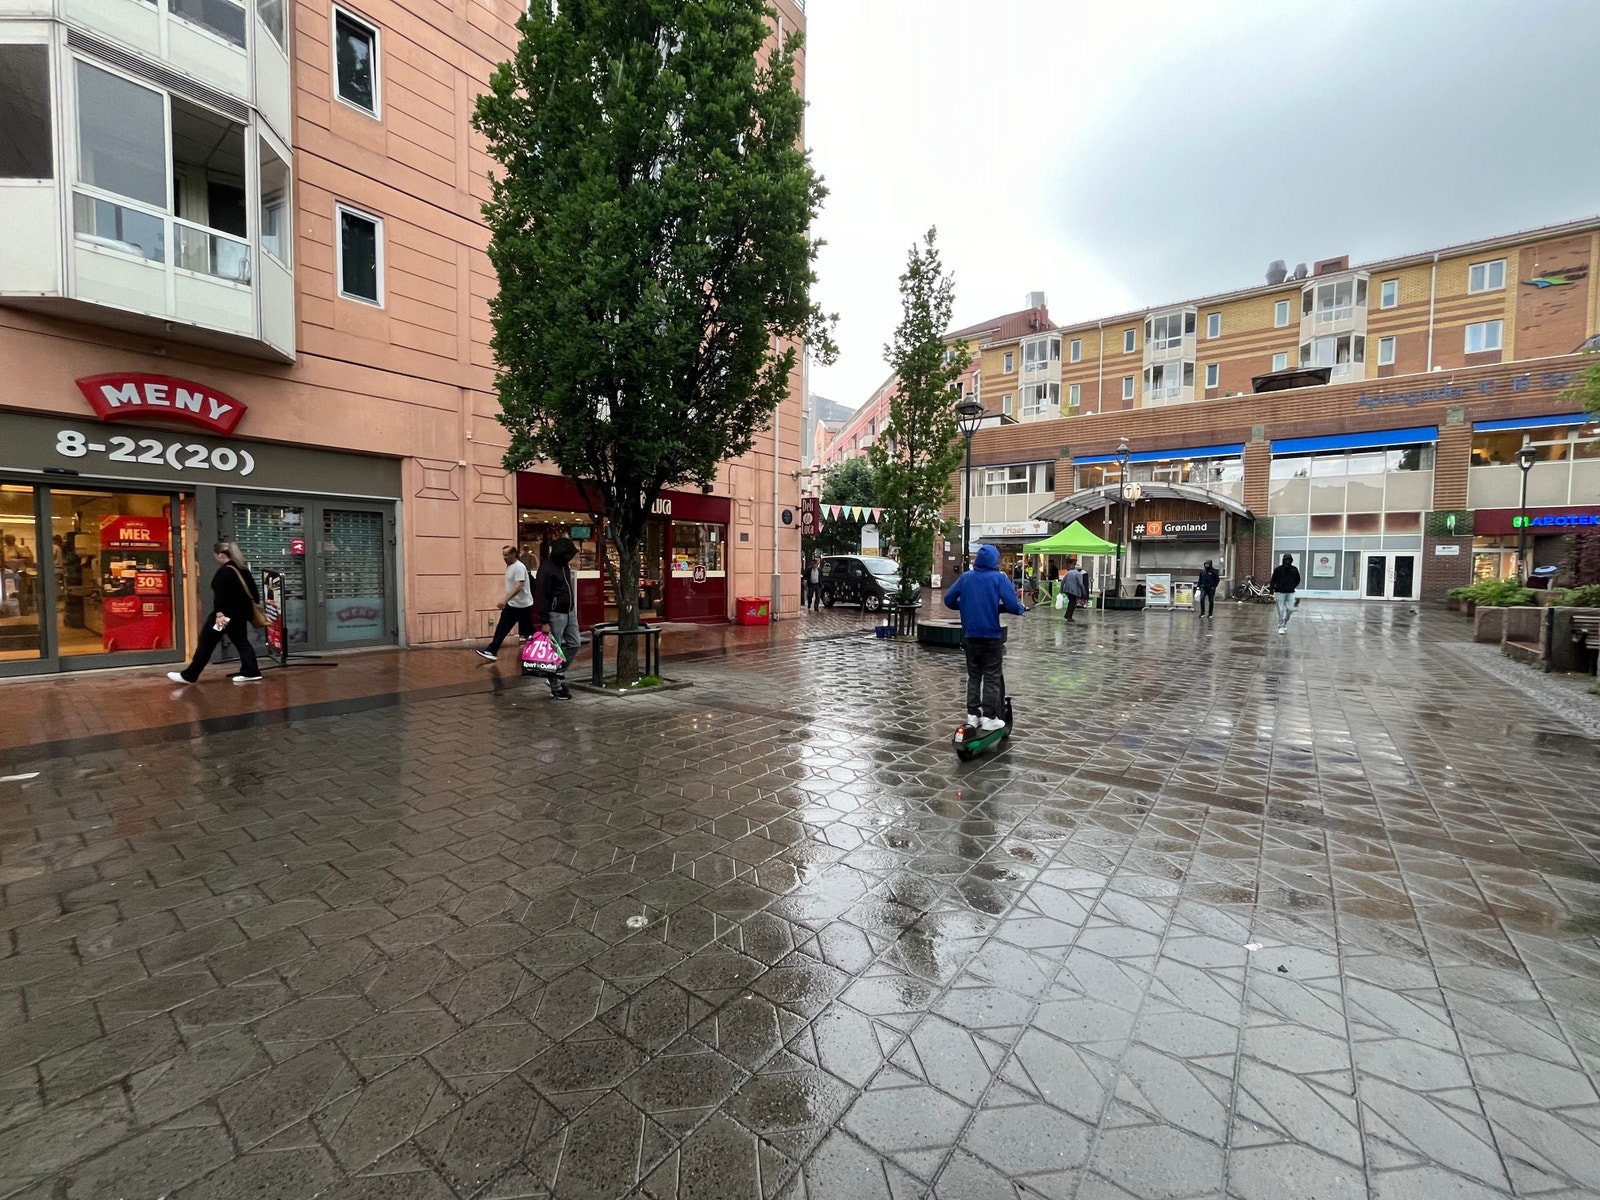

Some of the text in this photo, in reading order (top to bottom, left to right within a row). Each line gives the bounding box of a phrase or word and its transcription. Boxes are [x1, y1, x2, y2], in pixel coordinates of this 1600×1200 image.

[100, 382, 233, 421] MENY
[55, 430, 256, 477] 8-22(20)
[802, 498, 814, 512] Deli
[801, 521, 814, 535] Luca
[1164, 523, 1208, 532] Grønland
[1531, 515, 1600, 527] APOTEK
[119, 528, 151, 540] MER
